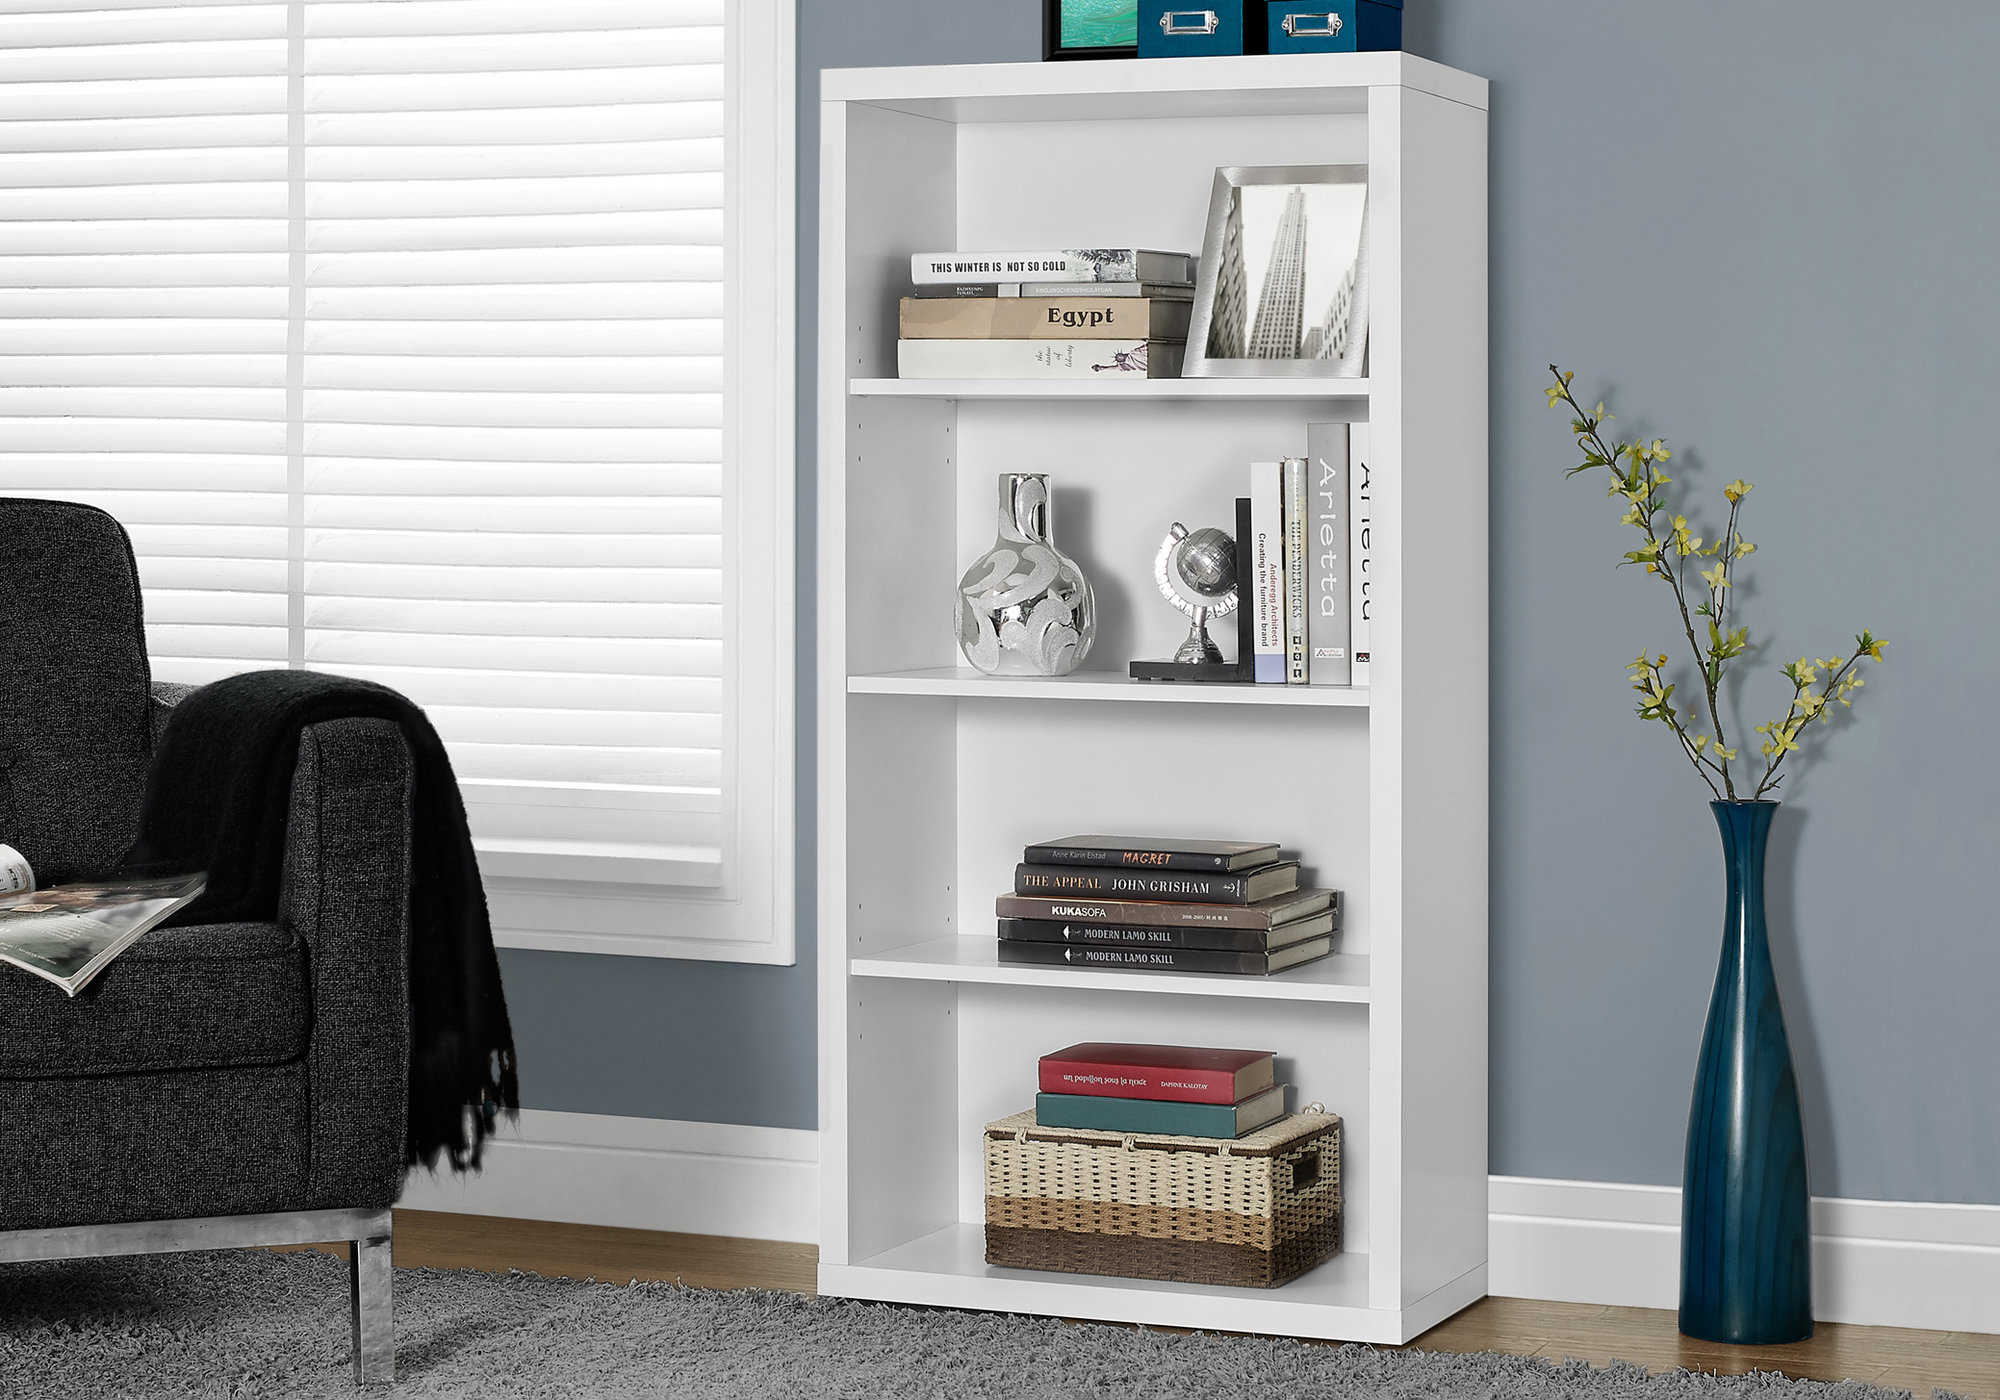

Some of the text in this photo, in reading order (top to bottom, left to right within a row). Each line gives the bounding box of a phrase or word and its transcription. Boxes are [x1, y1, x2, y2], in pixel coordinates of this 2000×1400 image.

[931, 260, 1066, 273] THIS WINTER IS NOT SO COLD
[1048, 307, 1115, 328] Egypt
[1319, 457, 1337, 617] Arletta
[1258, 532, 1269, 648] Creating the furniture brand
[1269, 563, 1279, 647] Anderegg Architects
[1122, 851, 1172, 865] MAGRET
[1024, 874, 1103, 889] THE APPEAL
[1111, 878, 1210, 894] JOHN GRISHAM
[1051, 905, 1107, 918] KUKASOFA
[1084, 928, 1172, 942] MODERN LAMO SKILL
[1085, 951, 1175, 965] MODERN LAMO SKILL
[1104, 1076, 1119, 1085] sous
